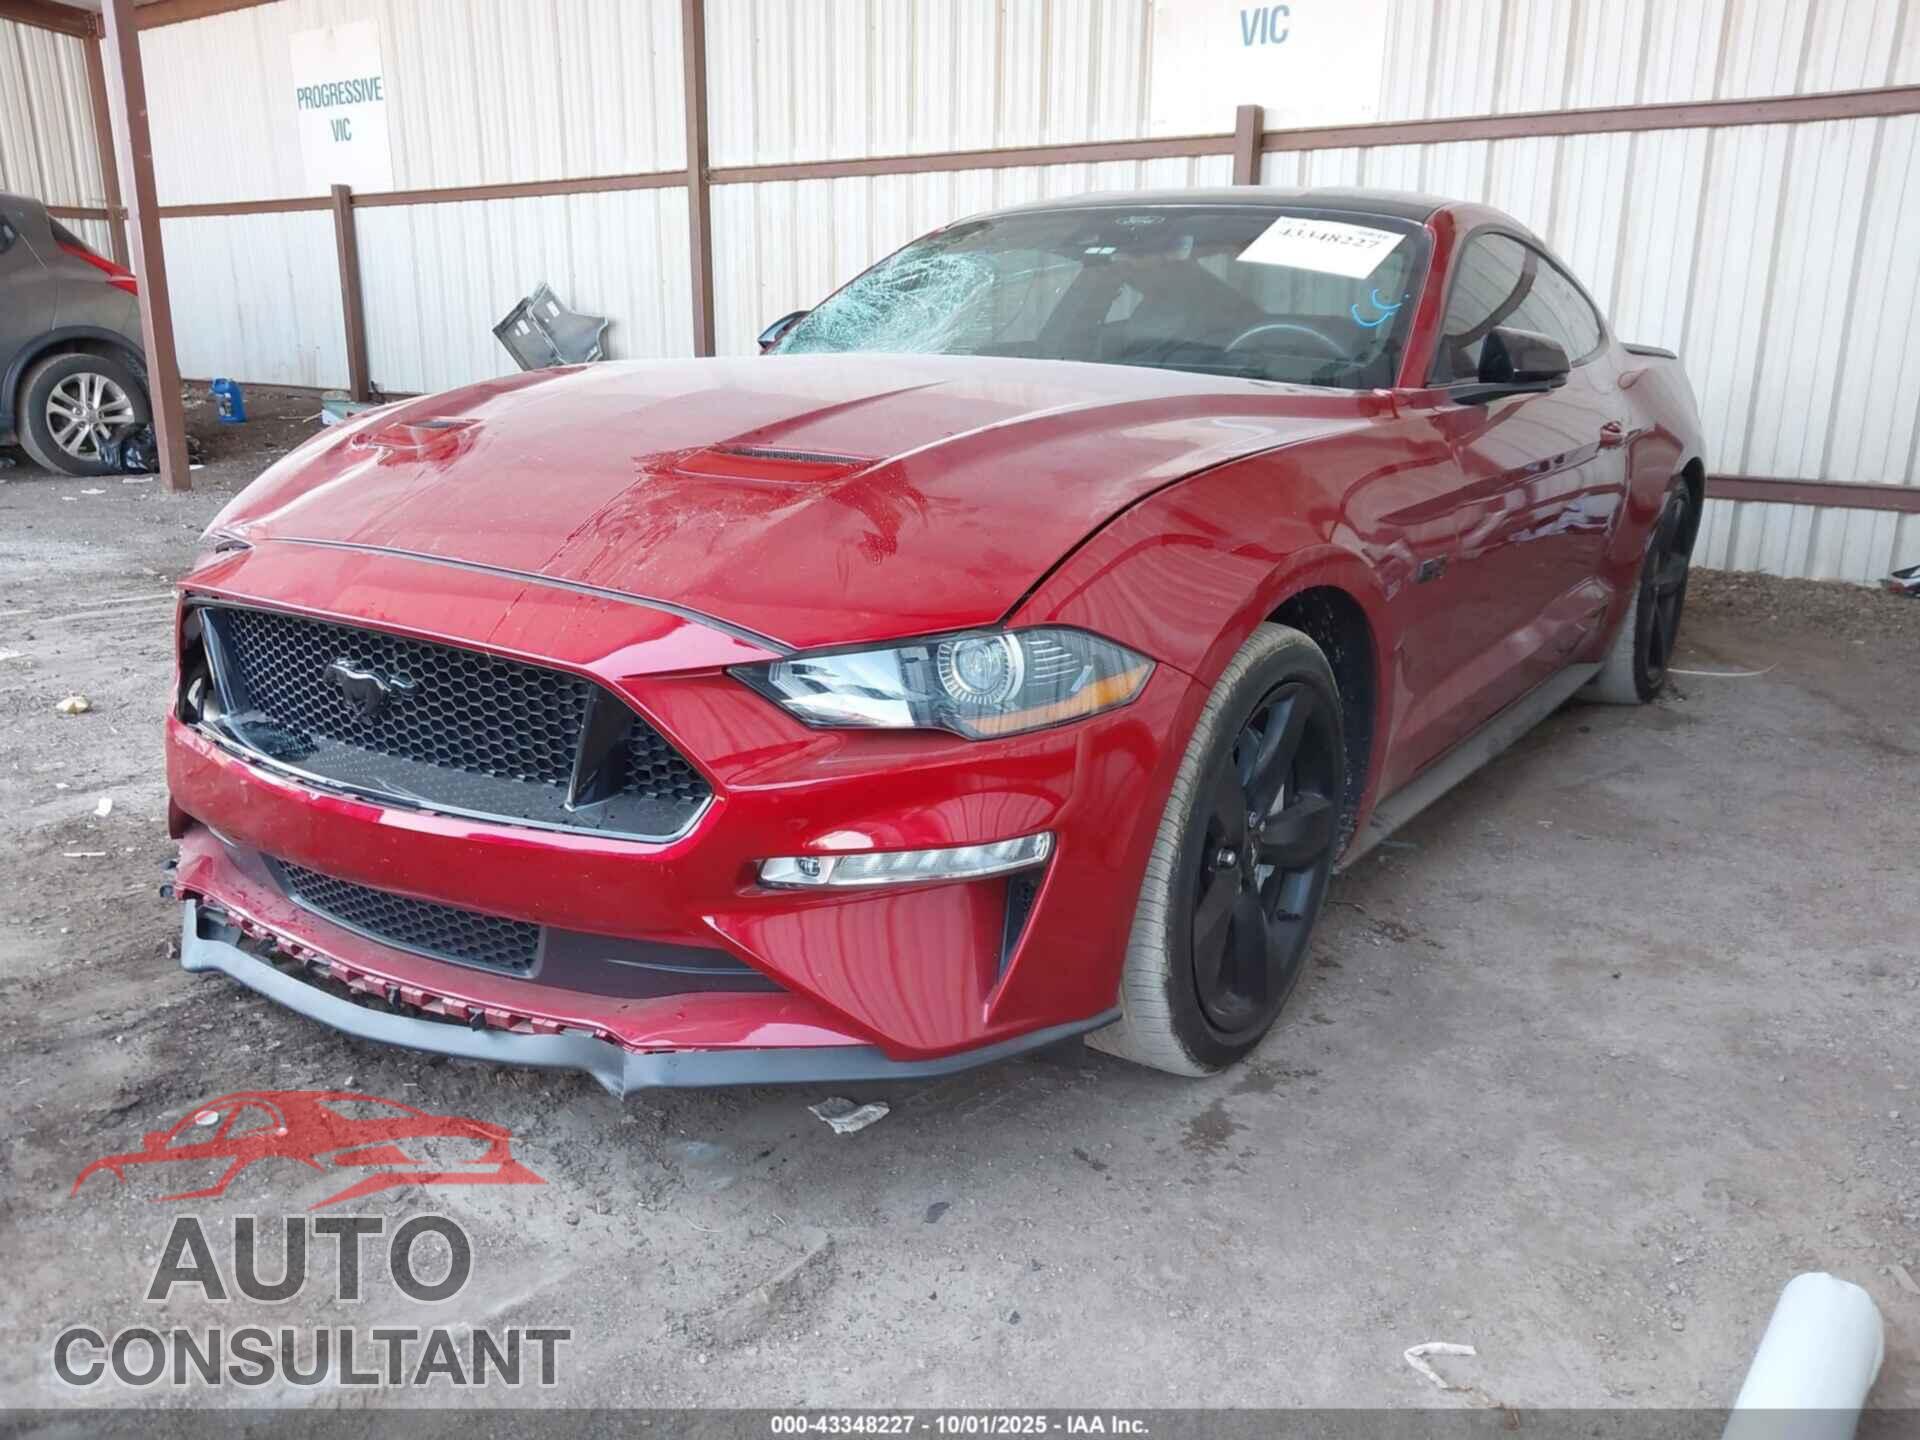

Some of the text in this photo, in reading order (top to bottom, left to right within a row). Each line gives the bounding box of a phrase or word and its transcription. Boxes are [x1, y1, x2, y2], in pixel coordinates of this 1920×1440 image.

[1240, 4, 1291, 46] VIC
[296, 77, 384, 109] PROGRESSIVE
[330, 117, 353, 142] VIC
